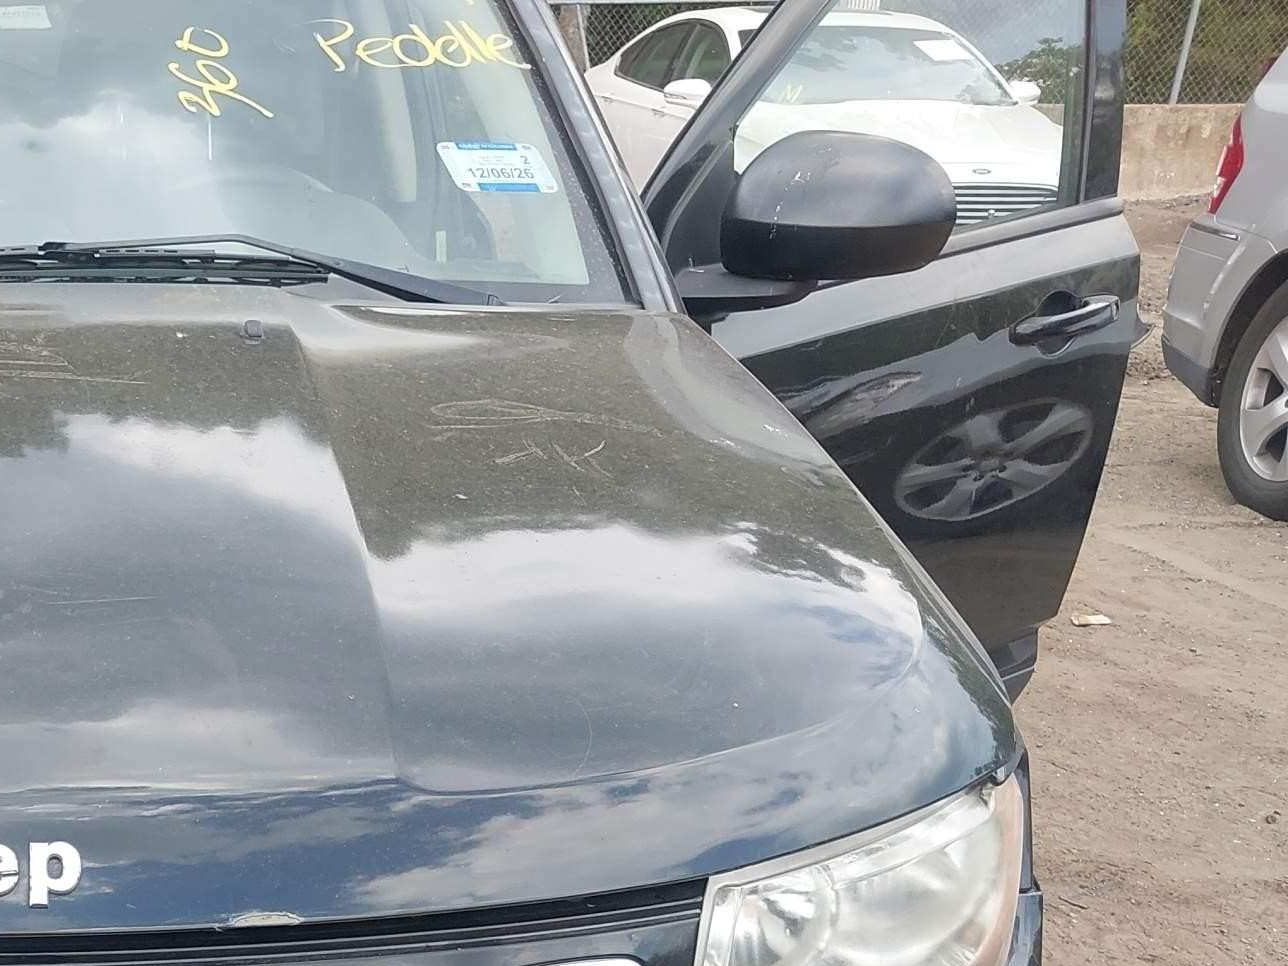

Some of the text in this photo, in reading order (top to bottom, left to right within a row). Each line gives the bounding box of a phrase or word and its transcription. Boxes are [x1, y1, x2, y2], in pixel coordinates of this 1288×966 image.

[168, 26, 274, 118] 360
[305, 18, 532, 72] Peddle
[467, 167, 535, 179] 12/06/26
